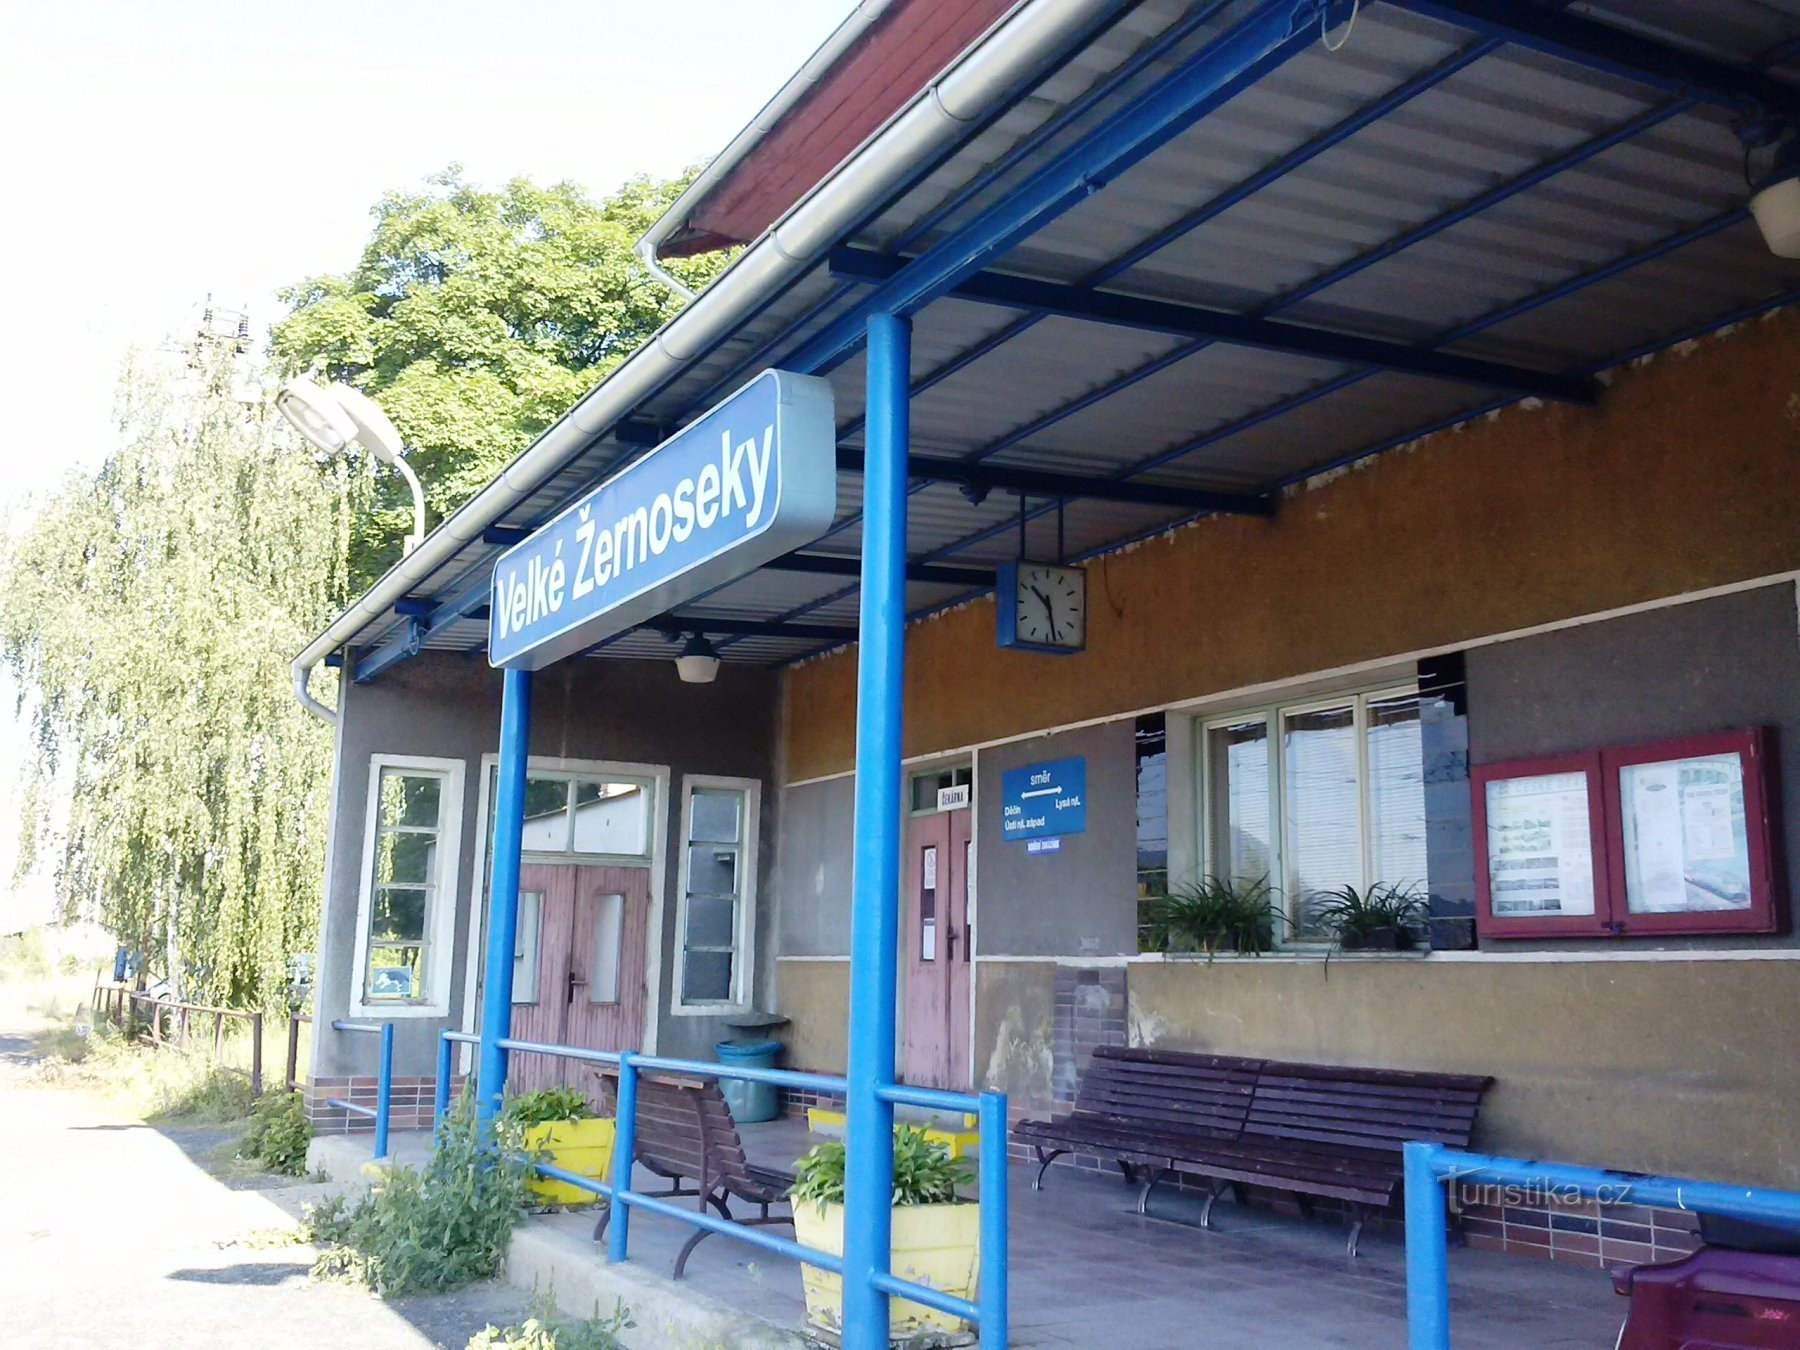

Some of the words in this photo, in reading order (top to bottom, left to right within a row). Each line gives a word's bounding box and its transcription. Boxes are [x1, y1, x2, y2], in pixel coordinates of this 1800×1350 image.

[498, 538, 566, 640] Velké
[572, 424, 774, 601] Žernoseky
[1030, 769, 1051, 786] směr
